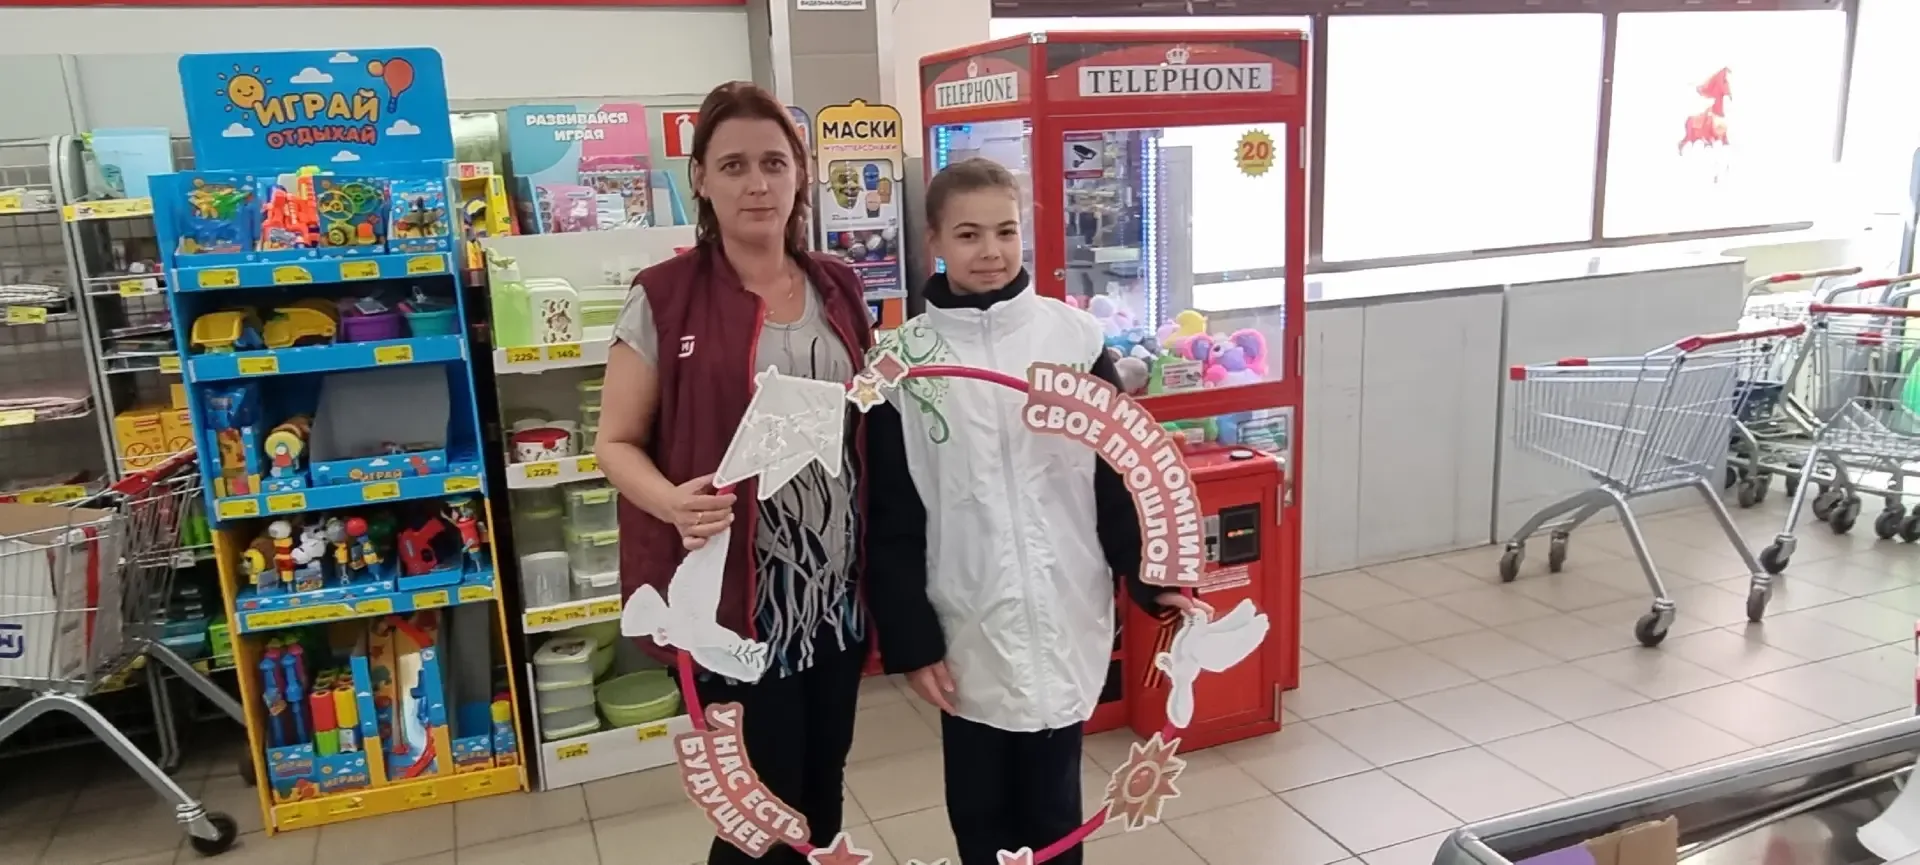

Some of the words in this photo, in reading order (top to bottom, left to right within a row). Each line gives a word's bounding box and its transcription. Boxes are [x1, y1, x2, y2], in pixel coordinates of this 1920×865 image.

[938, 76, 1013, 108] TELEPHONE
[1088, 66, 1262, 94] TELEPHONE
[253, 88, 380, 128] ИГРАЙ
[525, 111, 629, 126] РАЗВИВАЙСЯ
[266, 124, 377, 149] ОТДЫХАЙ
[554, 128, 605, 141] ИГРАЯ
[822, 120, 897, 139] МАСКИ
[1242, 141, 1269, 160] 20
[1034, 367, 1112, 412] ПОКА
[1112, 400, 1160, 449] МЫ
[1151, 445, 1200, 581] ПОМНИМ
[1027, 404, 1106, 444] СВОЕ
[1102, 433, 1169, 580] ПРОШЛОЕ
[712, 709, 737, 728] У
[713, 735, 751, 791] НАС
[681, 736, 771, 852] БУДУЩЕЕ
[741, 788, 804, 839] ЕСТЬ
